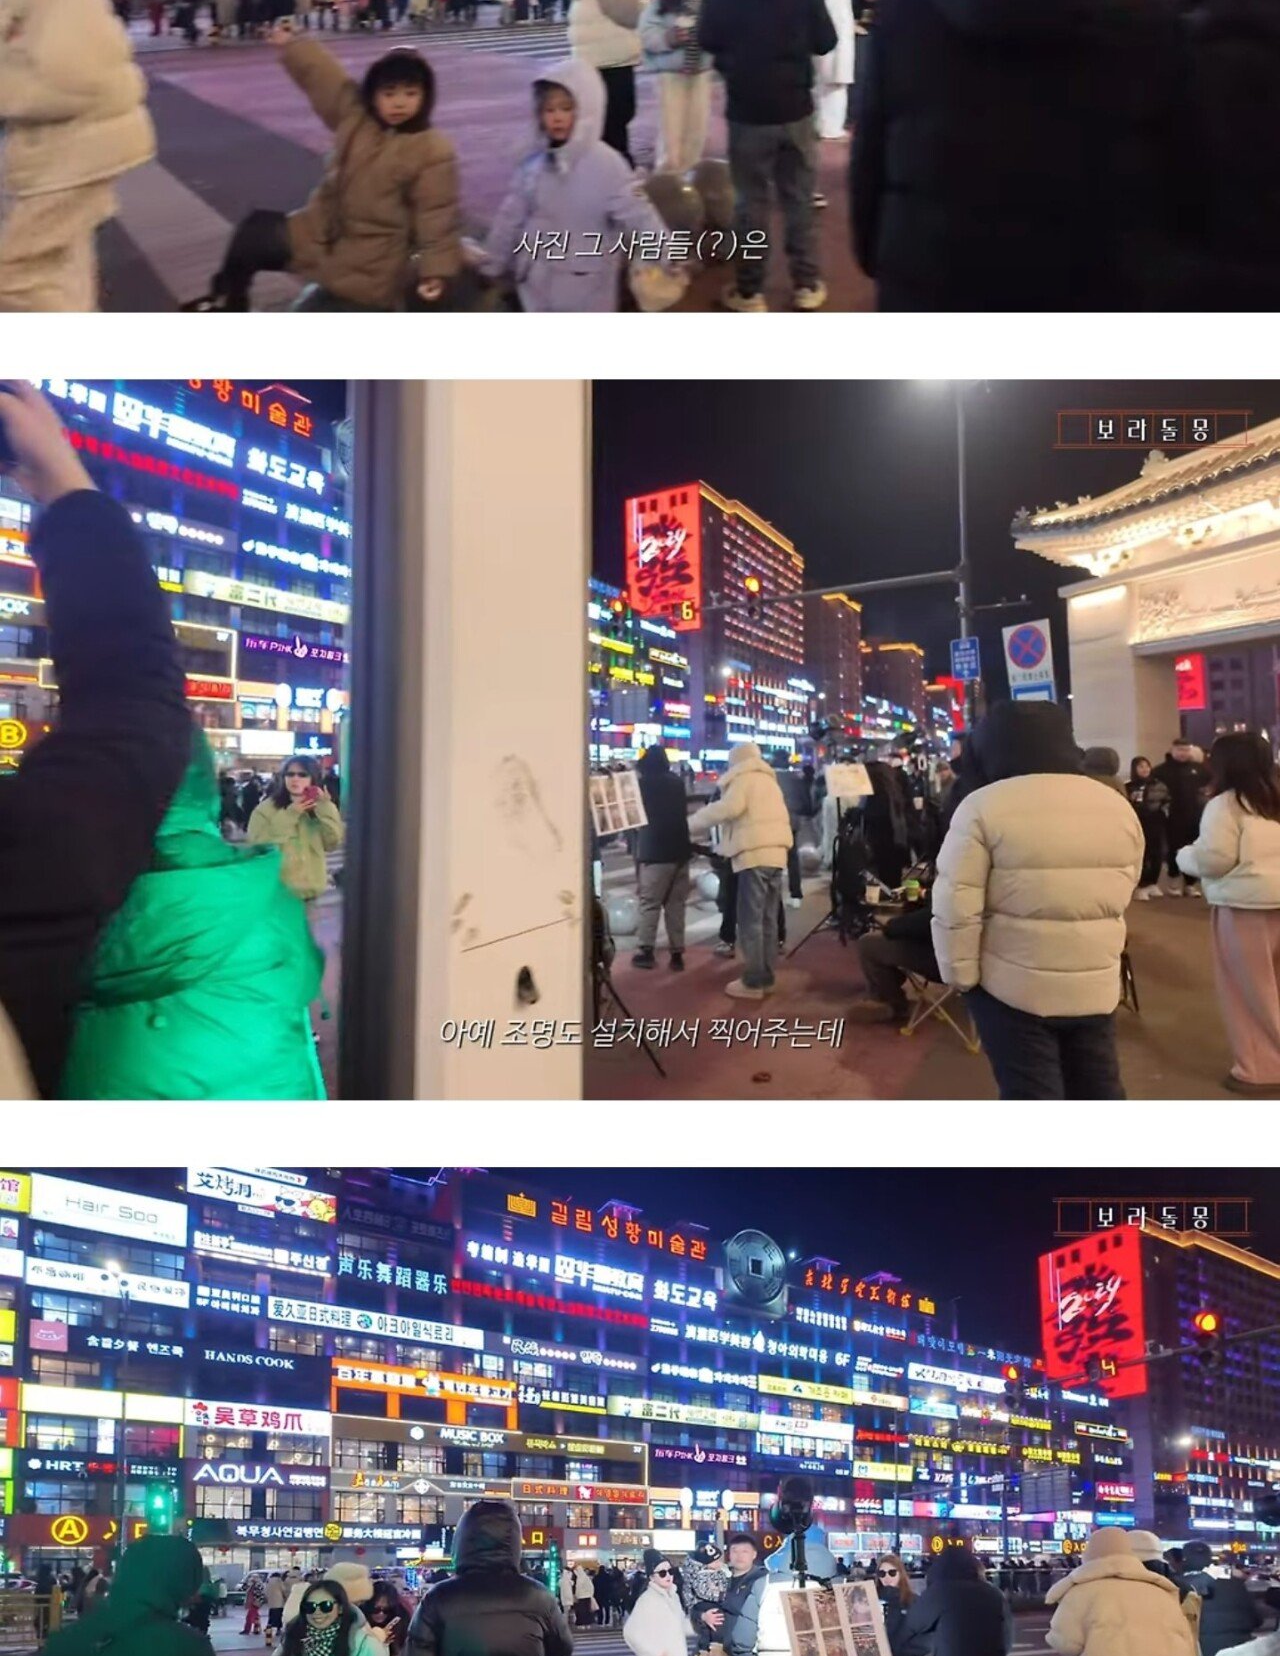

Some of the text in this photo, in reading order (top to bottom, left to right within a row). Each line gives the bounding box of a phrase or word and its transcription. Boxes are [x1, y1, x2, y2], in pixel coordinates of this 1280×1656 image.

[204, 1349, 295, 1370] HANDS COOK
[193, 1463, 284, 1485] AQUA
